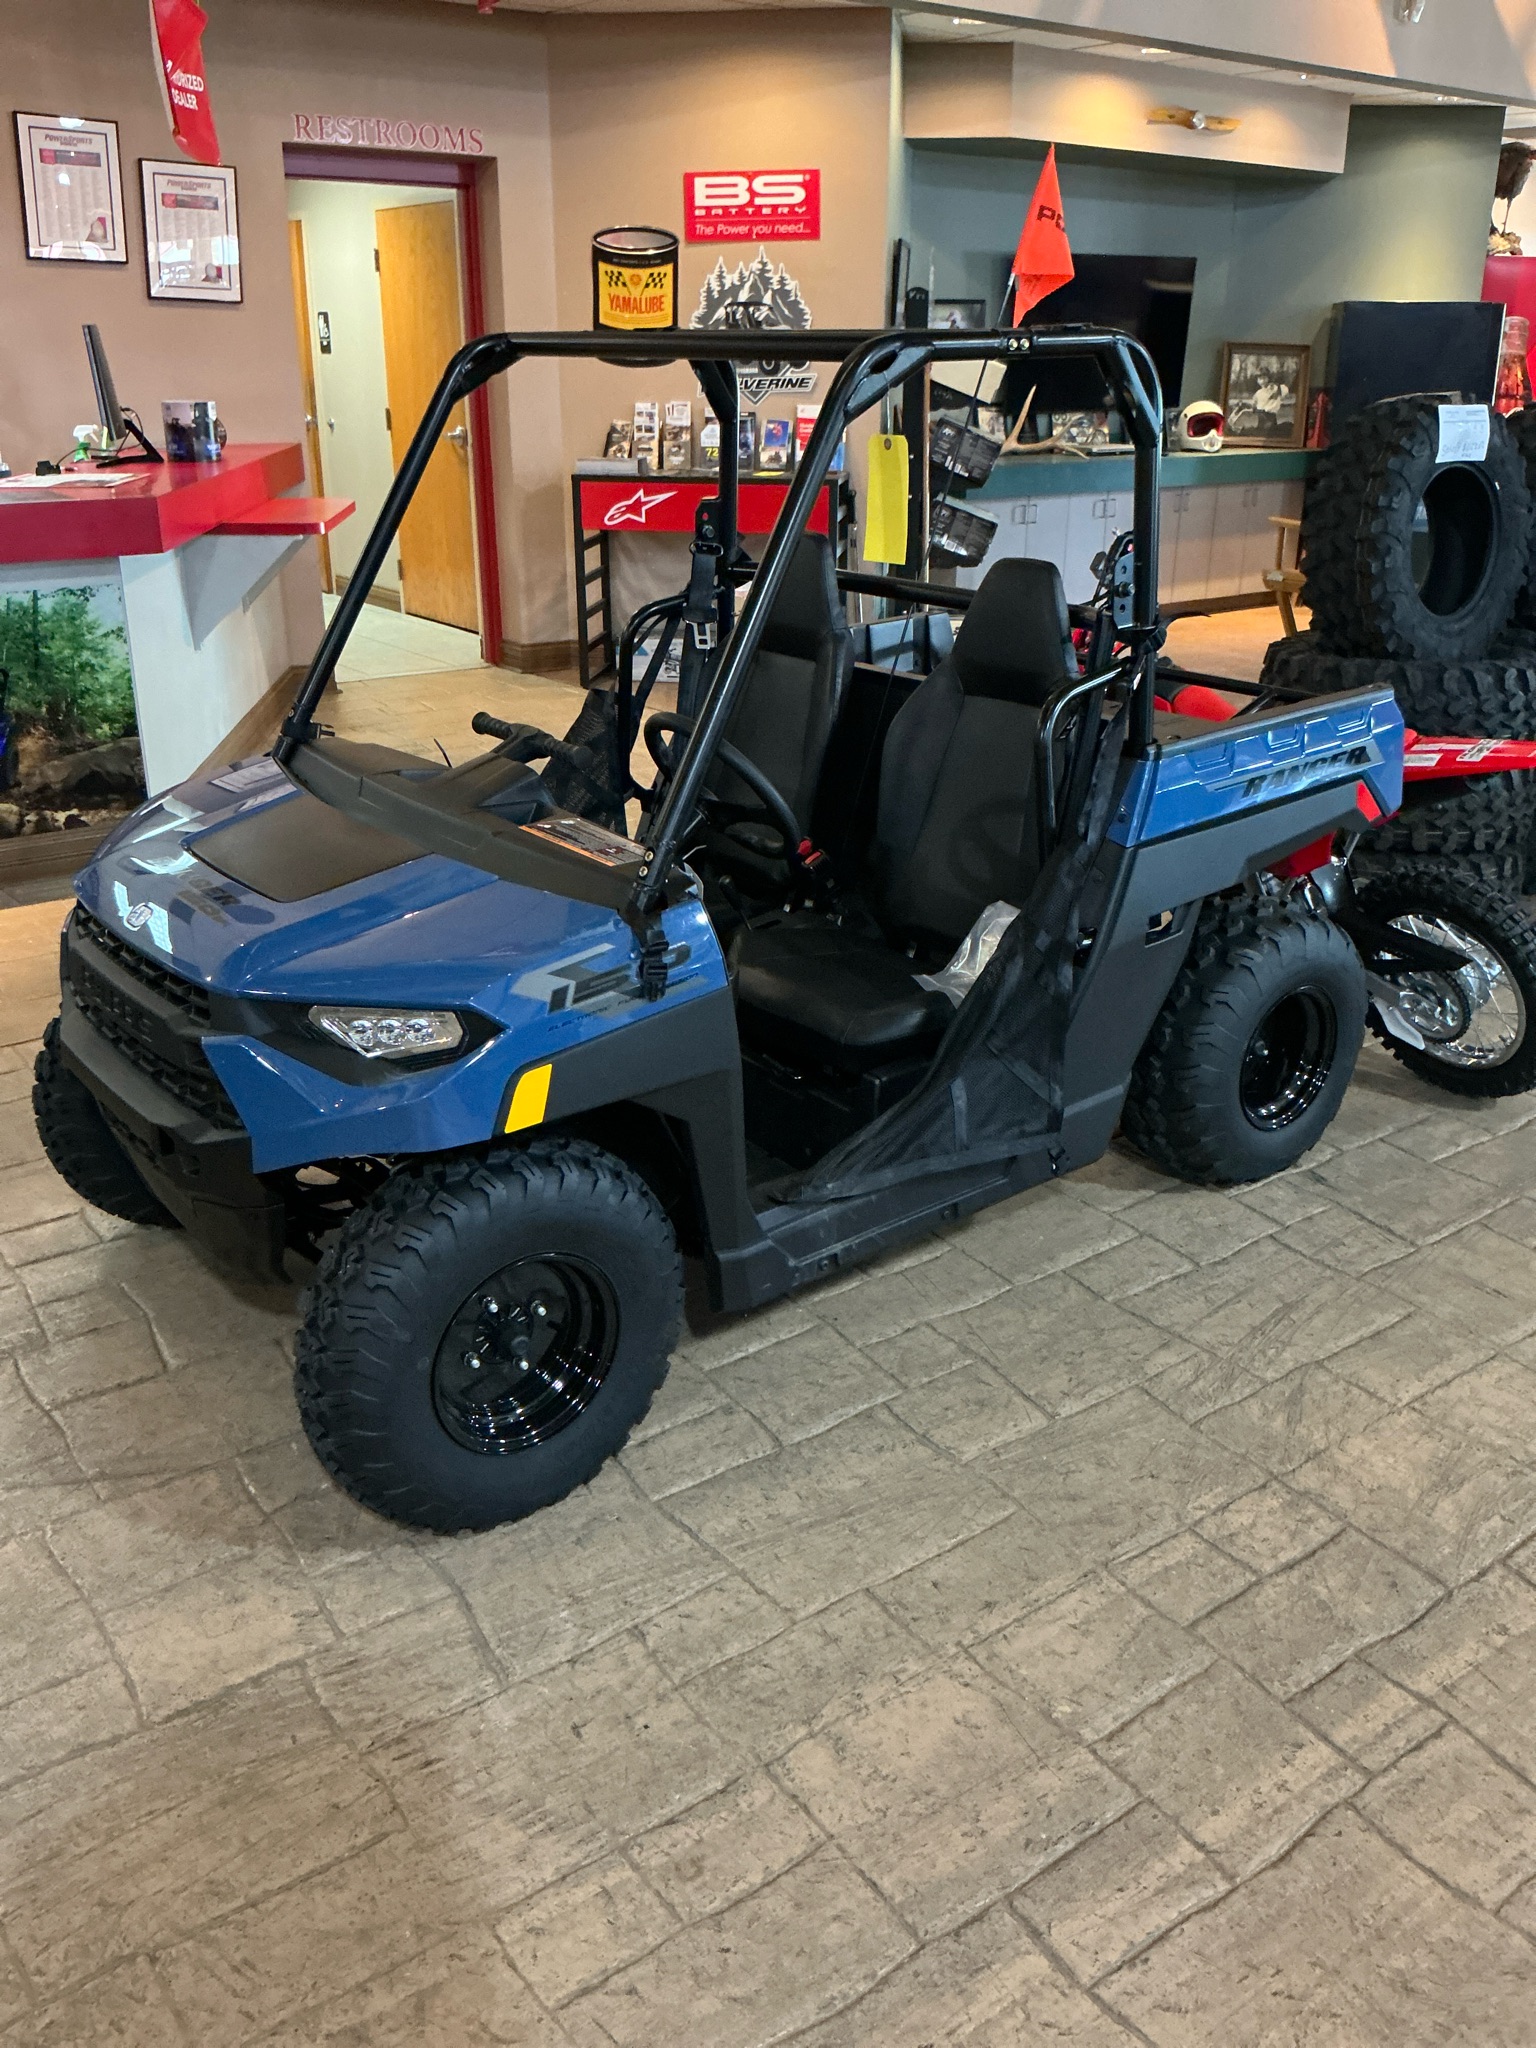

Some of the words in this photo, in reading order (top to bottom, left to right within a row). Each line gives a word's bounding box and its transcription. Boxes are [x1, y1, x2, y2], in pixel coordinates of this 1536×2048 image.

[293, 113, 484, 155] RESTROOMS
[694, 174, 806, 206] BS
[695, 206, 806, 216] BATTERY
[695, 224, 714, 235] The
[717, 223, 749, 235] Power
[752, 225, 772, 239] you
[608, 293, 665, 314] YAMALUBE
[739, 377, 812, 390] VERINE
[1241, 746, 1371, 798] RANGER
